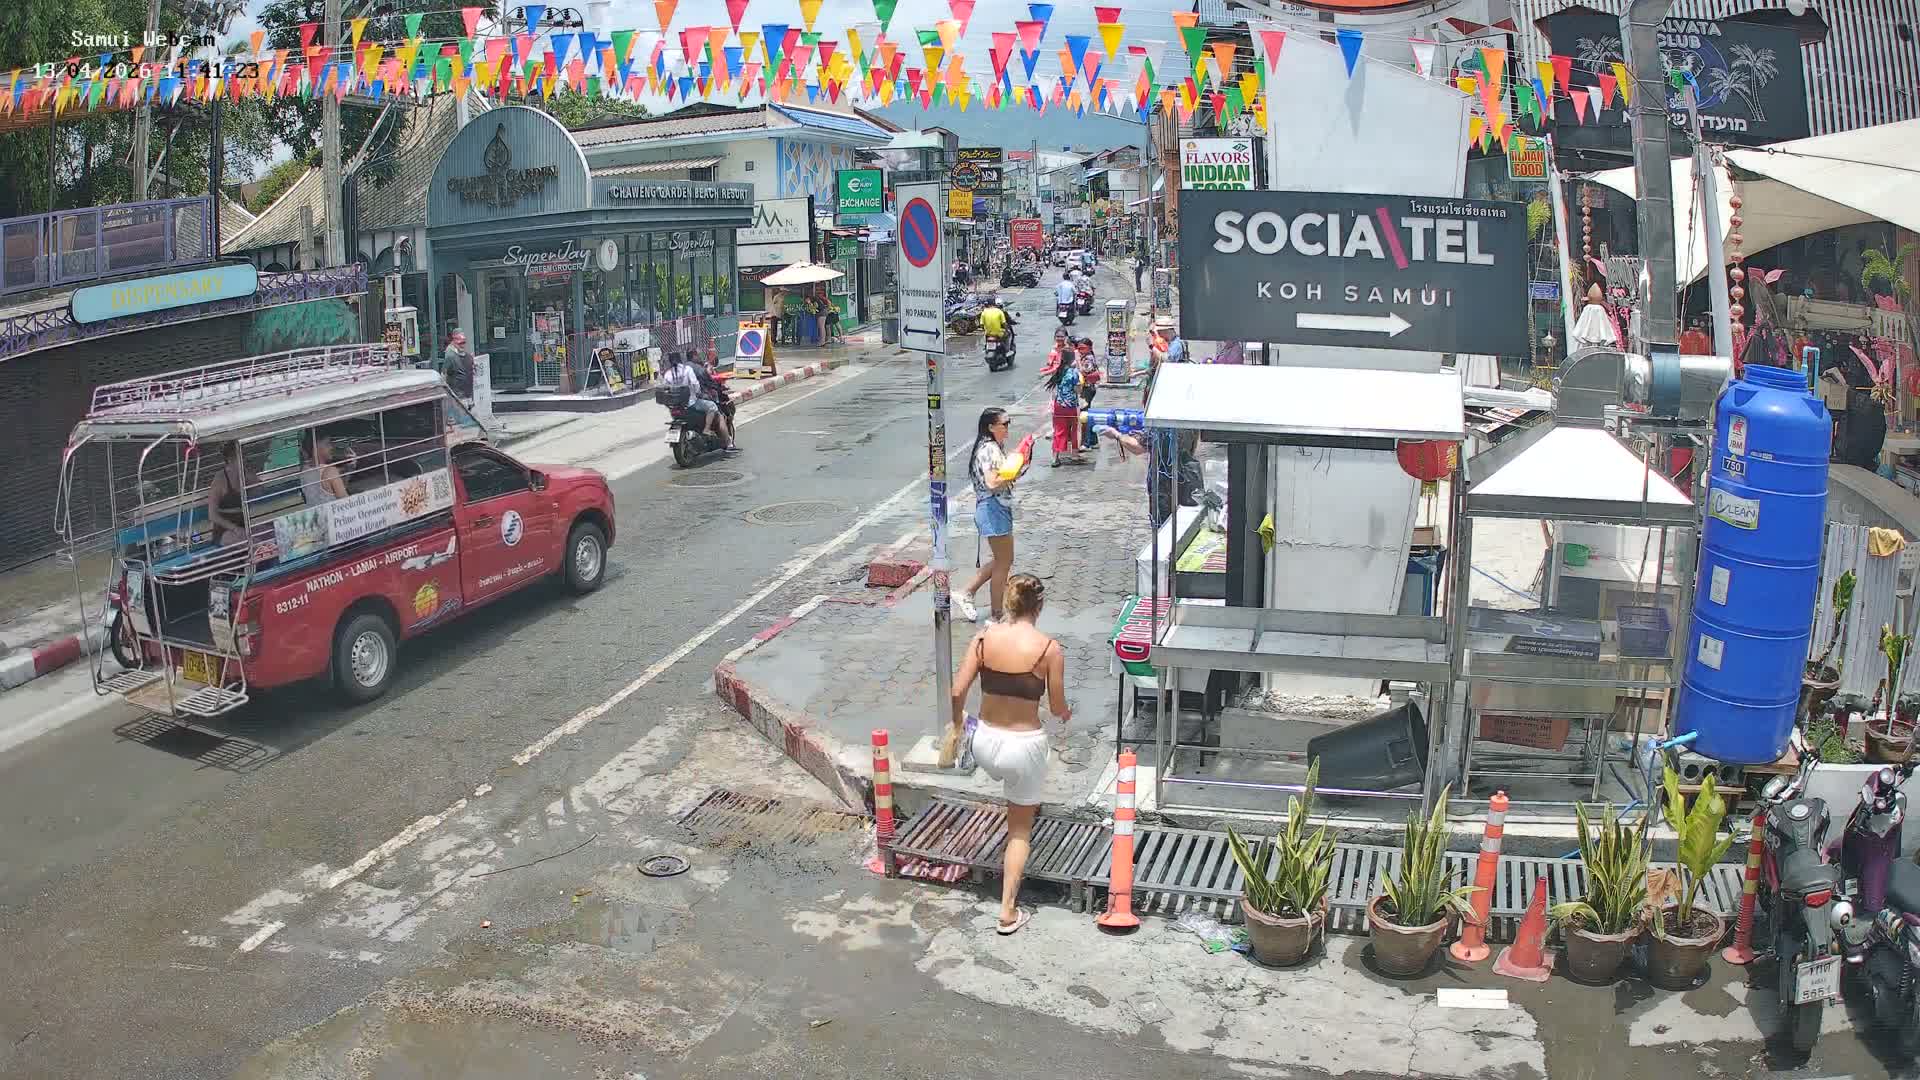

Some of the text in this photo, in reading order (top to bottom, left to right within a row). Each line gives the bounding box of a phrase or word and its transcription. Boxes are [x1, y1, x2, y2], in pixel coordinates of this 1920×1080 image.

[1656, 19, 1721, 37] ALVATA
[1185, 151, 1250, 164] FLAVORS
[1184, 164, 1250, 182] INDIAN
[1513, 163, 1544, 176] FOOD
[613, 185, 748, 200] CHAWENG GARDEN BEACH RESORT
[840, 198, 880, 208] EXCHANGE
[111, 273, 224, 310] DISPENSARY
[1257, 281, 1452, 307] KOH SAMUI
[905, 308, 938, 319] NO PARKING
[1726, 461, 1741, 472] 750
[306, 544, 420, 592] NATHON LAMAI AIRPORT
